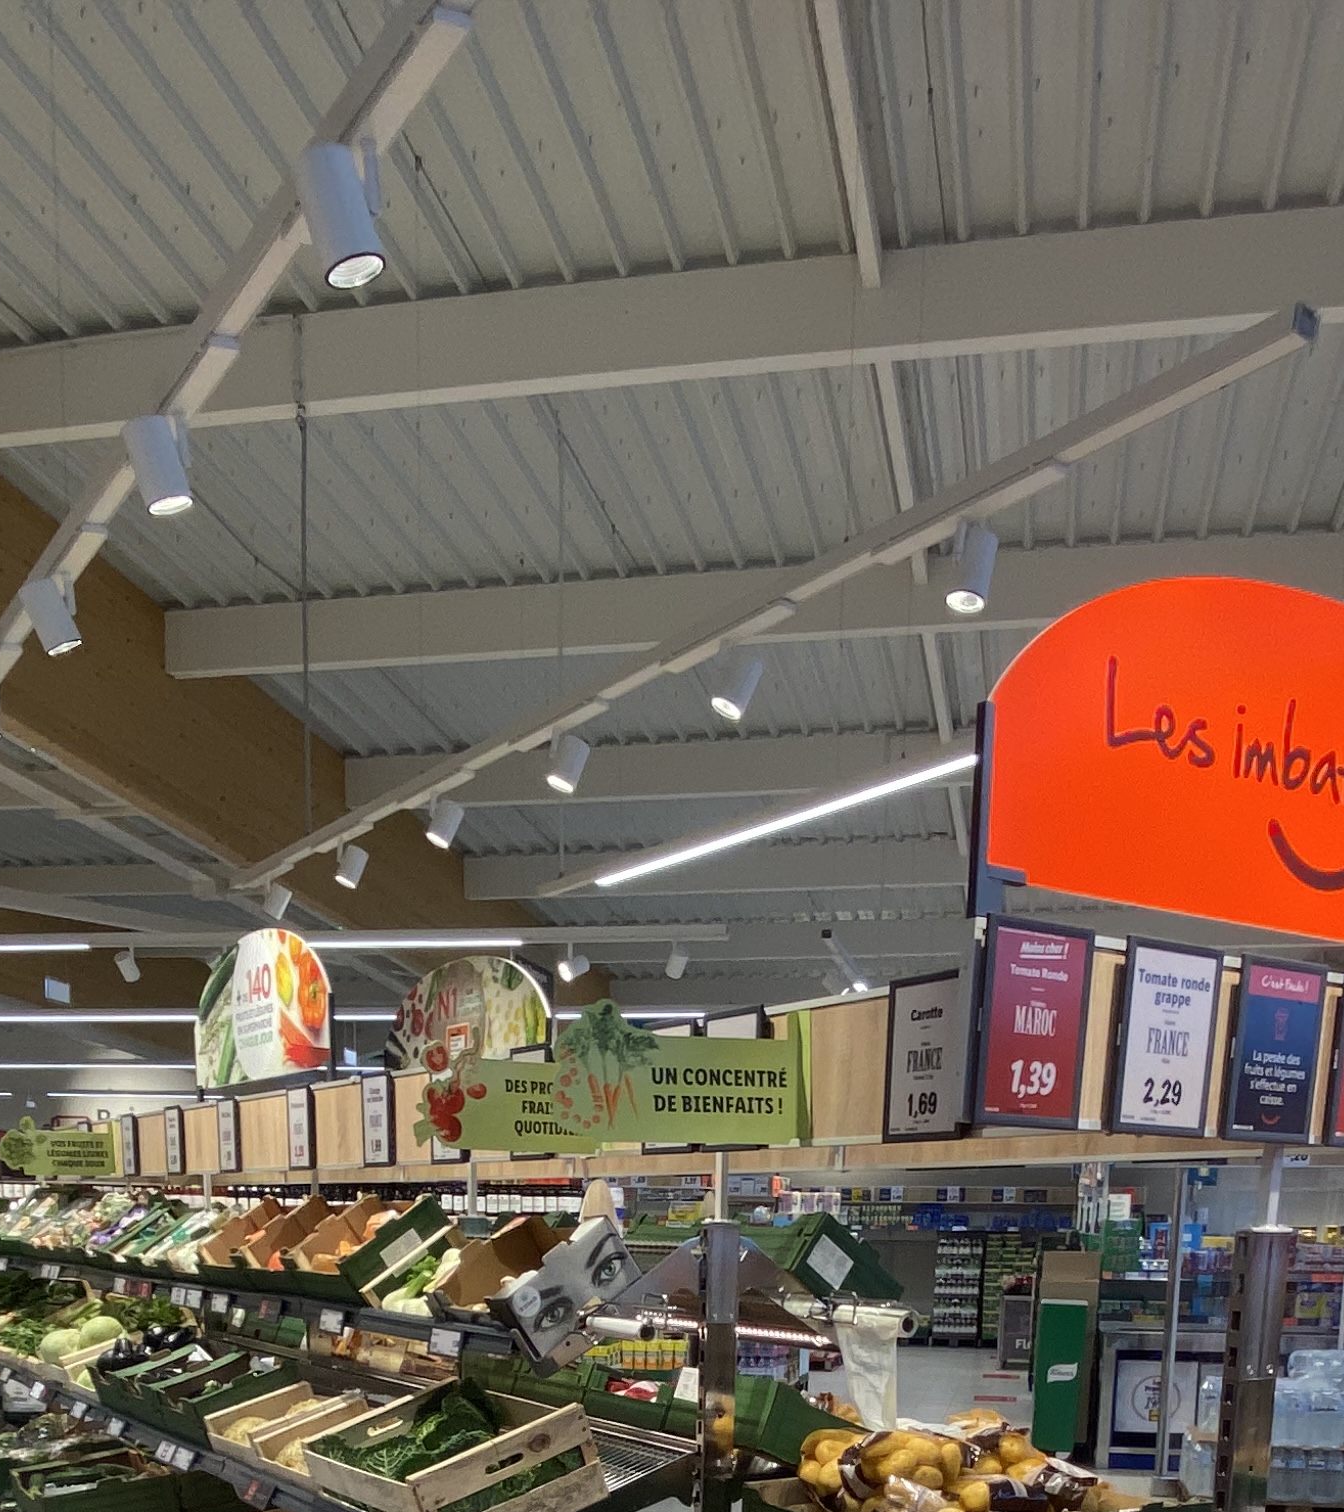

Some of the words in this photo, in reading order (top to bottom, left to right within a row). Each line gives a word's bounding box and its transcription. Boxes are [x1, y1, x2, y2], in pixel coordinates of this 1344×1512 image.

[1106, 655, 1216, 769] Les
[1010, 963, 1040, 978] Tomate
[1138, 968, 1178, 988] Tomate
[1181, 978, 1211, 993] ronde
[246, 963, 272, 1004] 140
[1154, 992, 1192, 1009] grappe
[910, 1006, 944, 1022] Carotte
[1013, 1004, 1058, 1037] MAROC
[1146, 1027, 1189, 1057] FRANCE
[907, 1047, 943, 1073] FRANCE
[1252, 1050, 1262, 1061] La
[1287, 1054, 1301, 1066] des
[505, 1079, 527, 1094] DES
[651, 1068, 677, 1086] UN
[683, 1067, 788, 1088] CONCENTRÉ
[1011, 1059, 1056, 1098] 1,39
[654, 1095, 677, 1112] DE
[682, 1095, 774, 1114] BIENFAITS
[1142, 1077, 1182, 1107] 2,29
[907, 1092, 937, 1119] 1,69
